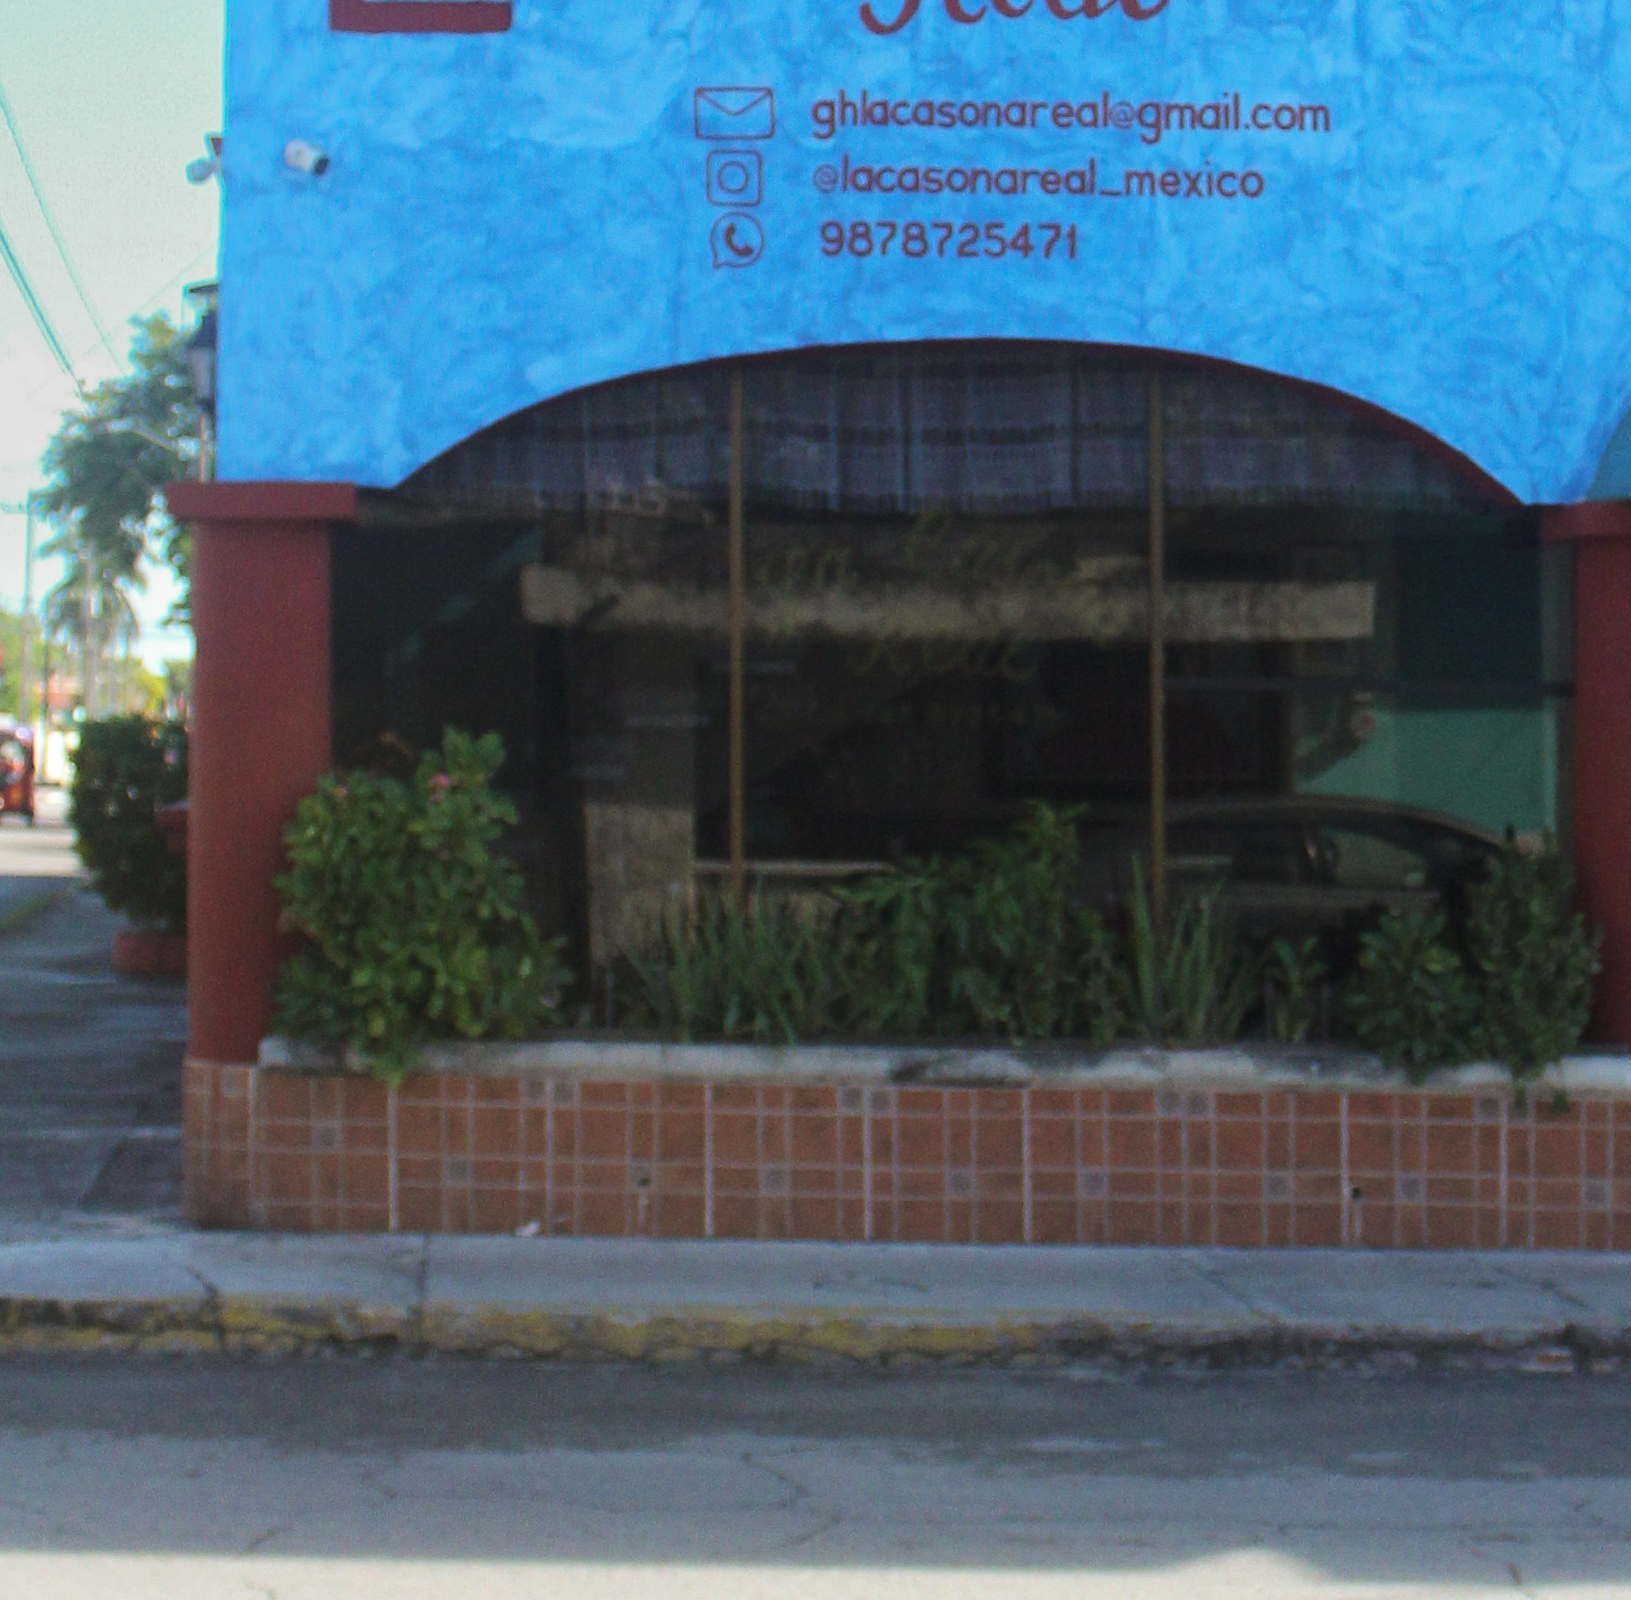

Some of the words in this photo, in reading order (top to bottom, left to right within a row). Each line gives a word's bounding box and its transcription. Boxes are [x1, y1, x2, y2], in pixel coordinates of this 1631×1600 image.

[811, 88, 1331, 145] ghlacasonareal@gmail.com
[812, 153, 1265, 199] @lacasonareal_mexico
[819, 218, 1078, 260] 9878725471
